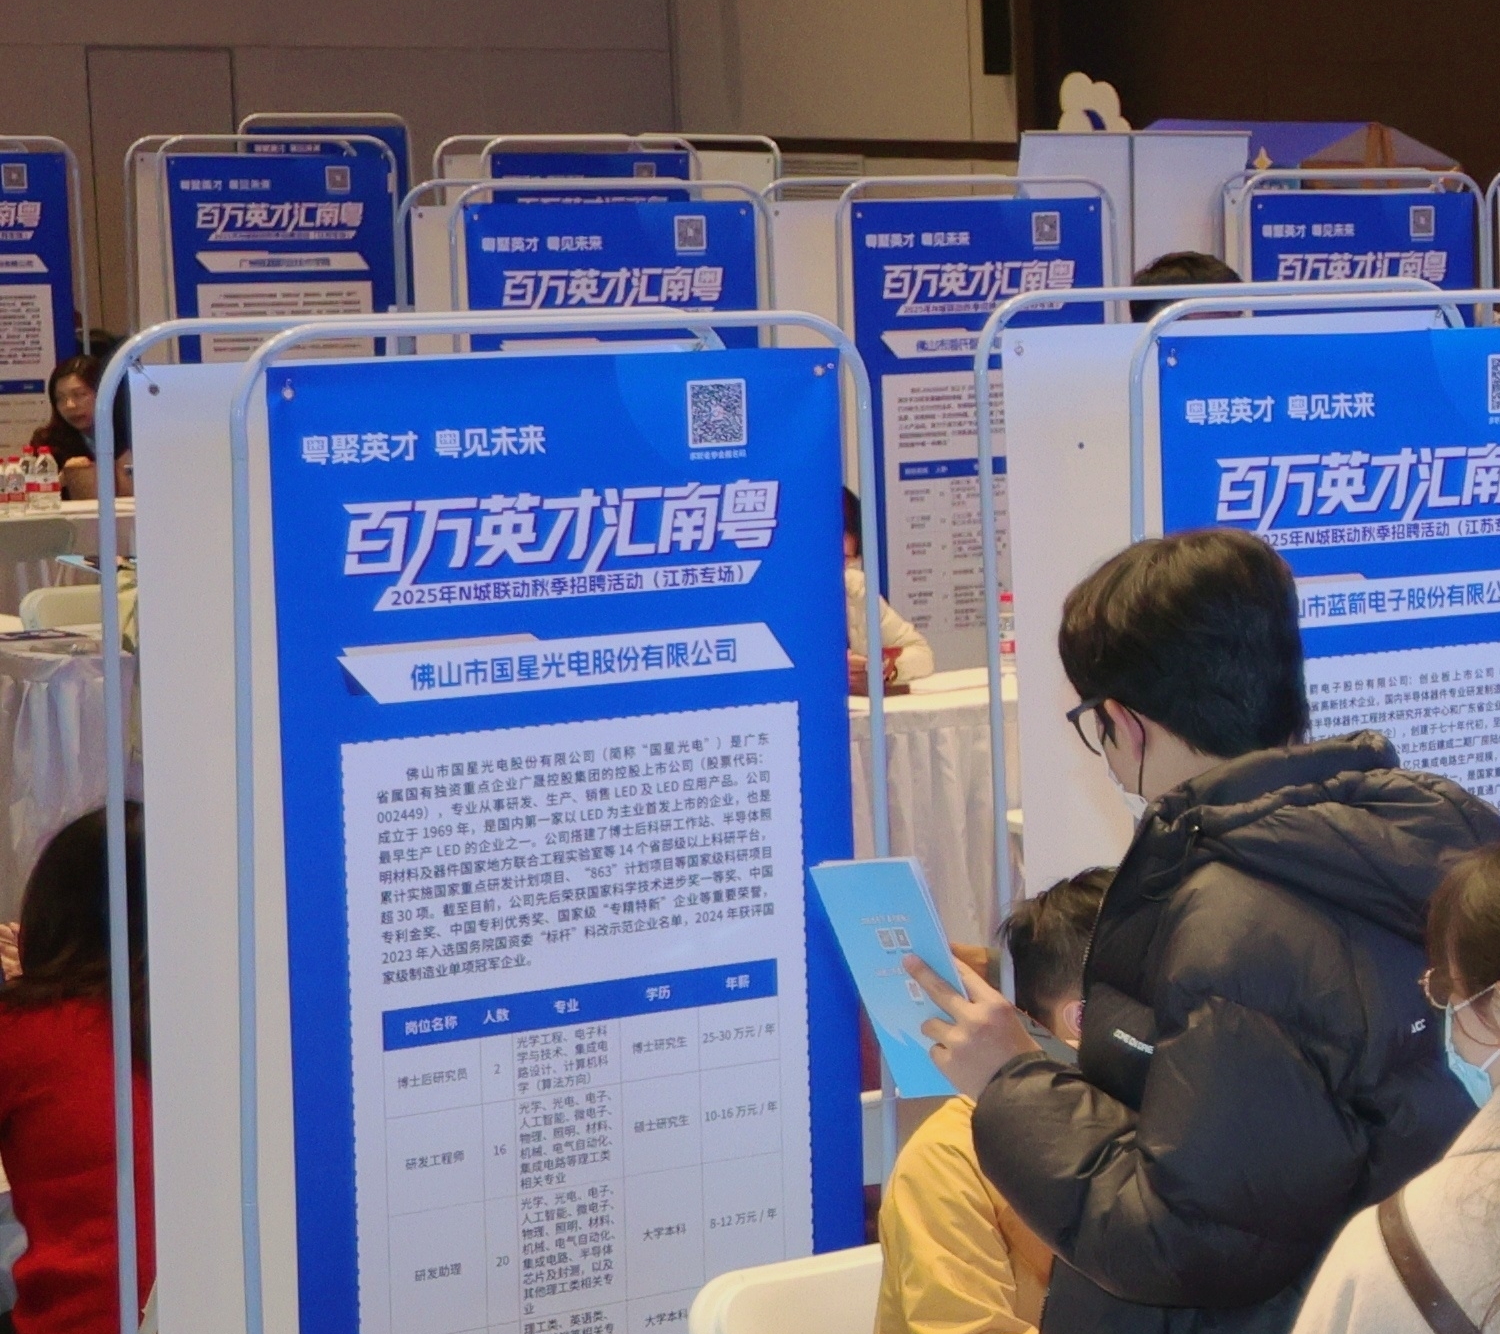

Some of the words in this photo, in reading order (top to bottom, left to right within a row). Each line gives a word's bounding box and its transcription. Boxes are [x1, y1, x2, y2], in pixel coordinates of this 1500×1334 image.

[196, 201, 364, 234] 百万英才汇南粤
[1277, 249, 1448, 282] 百万英才汇南粤
[502, 266, 724, 310] 百万英才汇南粤
[883, 259, 1076, 305] 百万英才汇南粤
[1185, 395, 1276, 427] 粤聚英才
[1287, 390, 1376, 422] 粤见未来
[301, 432, 419, 467] 粤聚英才
[434, 424, 547, 460] 粤见未来
[343, 478, 779, 586] 百万英才汇南粤
[390, 564, 745, 607] 2025年N城联动秋季招聘活动（江苏专场）
[410, 638, 737, 690] 佛山市国星光电股份有限公司
[553, 998, 580, 1015] 专业
[645, 985, 671, 1002] 学历
[405, 1015, 458, 1036] 岗位名称
[483, 1008, 510, 1025] 人数
[494, 1064, 501, 1075] 2
[493, 1144, 507, 1156] 16
[643, 1223, 687, 1241] 大学本科
[415, 1263, 462, 1282] 研发助理
[496, 1255, 510, 1267] 20
